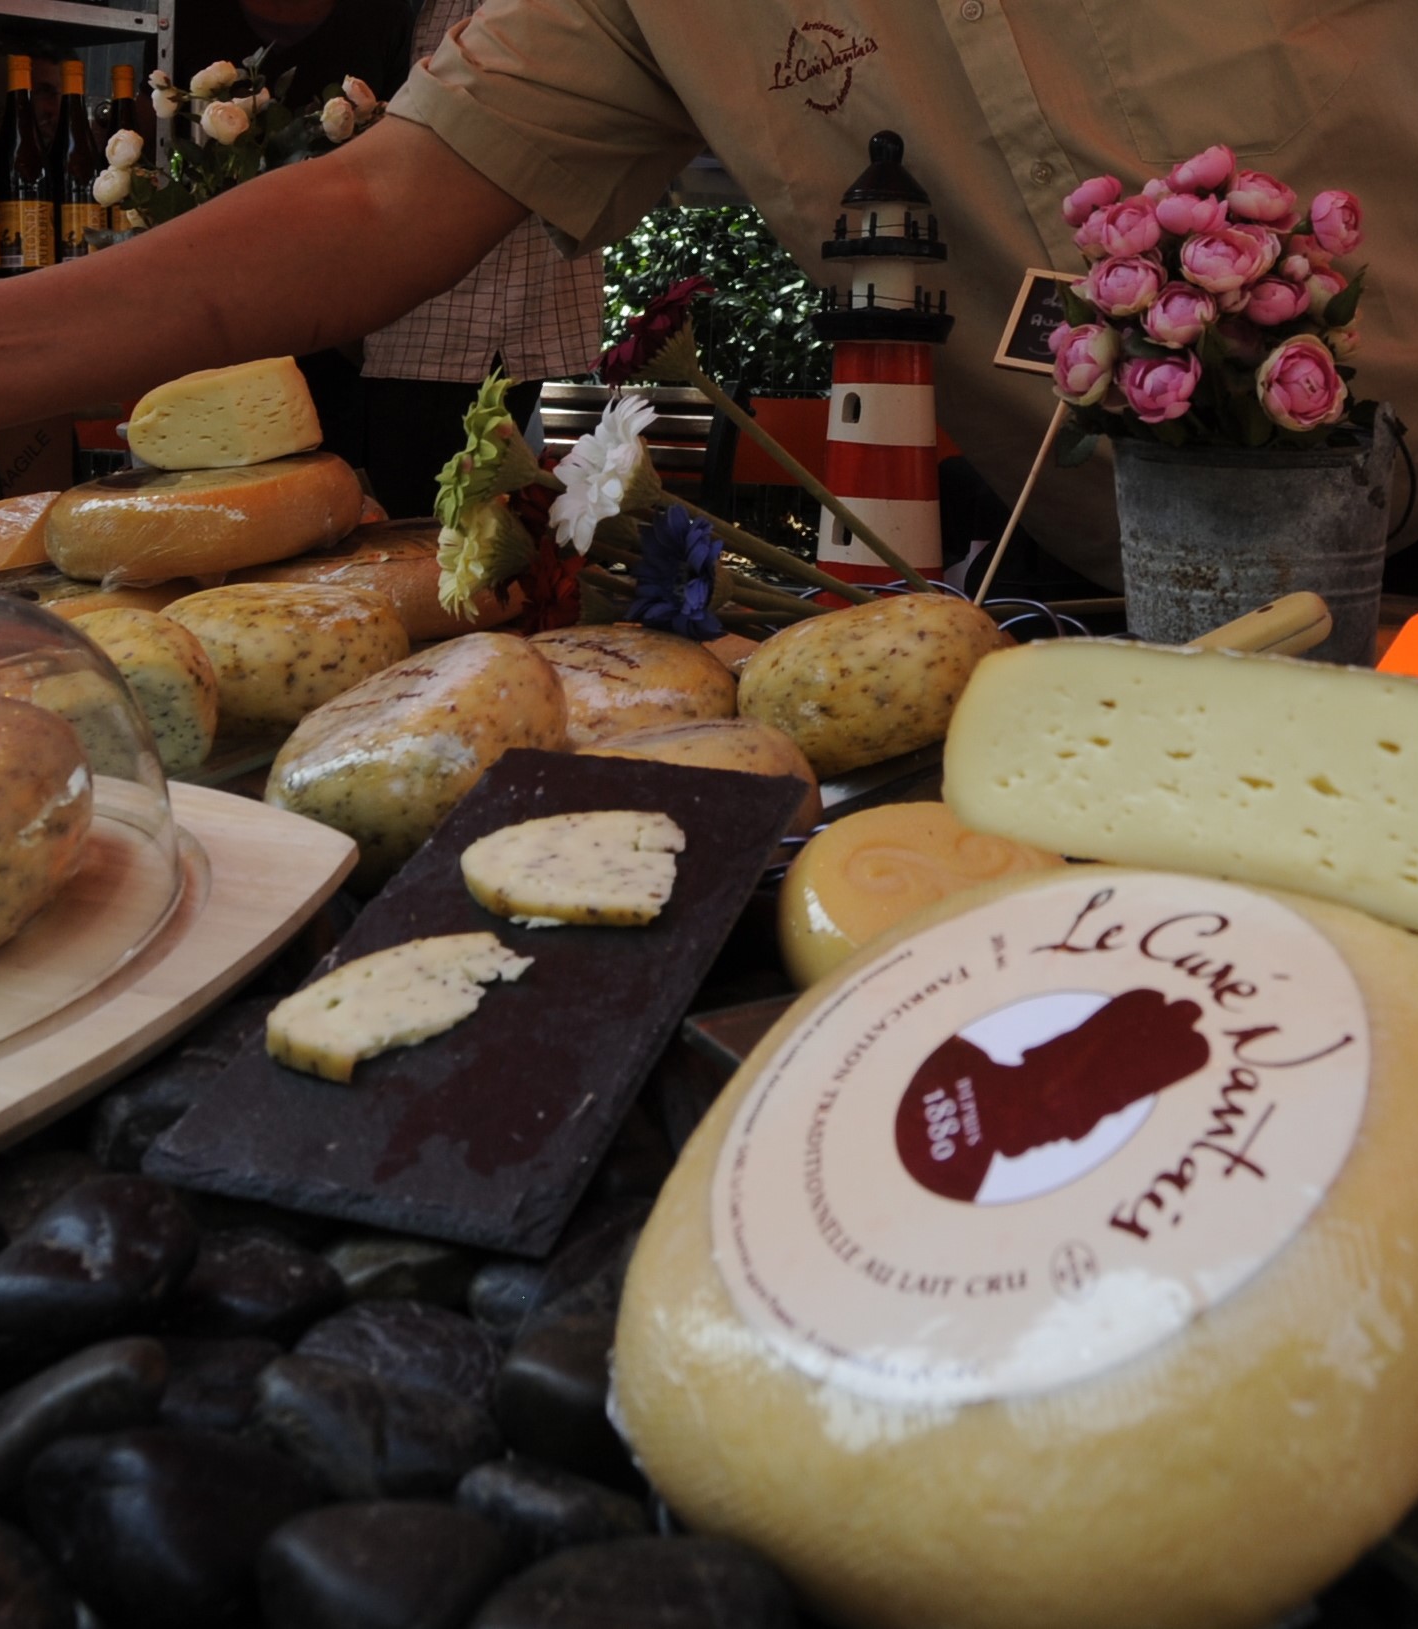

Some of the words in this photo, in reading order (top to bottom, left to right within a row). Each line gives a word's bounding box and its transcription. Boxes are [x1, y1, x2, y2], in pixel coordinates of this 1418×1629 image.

[1031, 888, 1127, 955] Le
[1138, 911, 1293, 1016] Curé
[921, 1087, 961, 1162] 1880
[1107, 1024, 1357, 1244] Nantais
[897, 1268, 959, 1299] LAIT
[963, 1267, 1030, 1298] CRU
